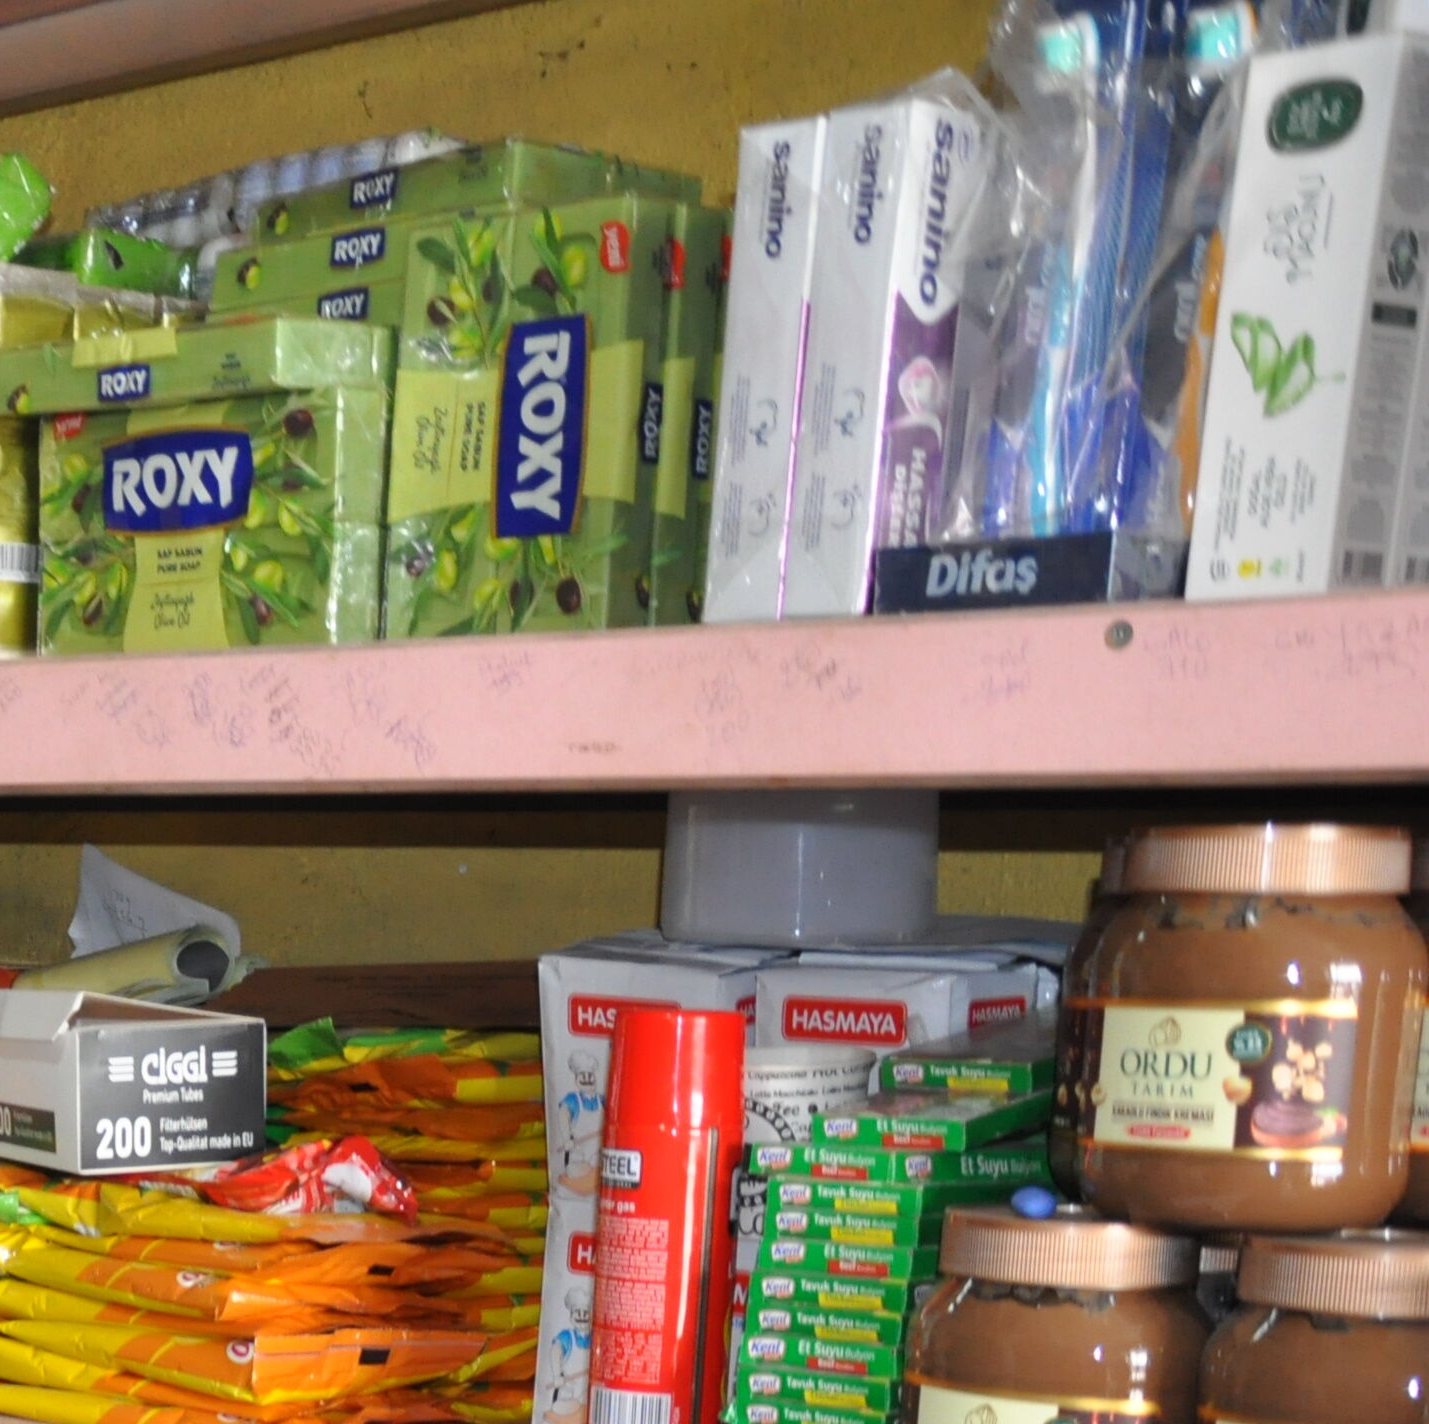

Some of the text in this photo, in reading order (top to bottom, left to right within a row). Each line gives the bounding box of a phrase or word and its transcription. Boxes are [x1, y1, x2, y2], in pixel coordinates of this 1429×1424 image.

[352, 171, 396, 205] ROXY
[333, 229, 384, 265] ROXY
[320, 291, 367, 318] ROXY
[101, 370, 147, 397] ROXY
[510, 331, 571, 520] ROXY
[112, 446, 239, 517] ROXY
[792, 1009, 896, 1035] HASMAYA
[971, 1003, 1025, 1024] HASMAYA
[894, 1065, 986, 1078] Kent Tavuk Suyu
[1121, 1048, 1212, 1080] ORDU
[143, 1087, 204, 1104] Premium Tubes
[1132, 1082, 1194, 1098] TARIM
[826, 1119, 919, 1134] Kent Et Suyu
[96, 1117, 152, 1160] 200
[210, 1131, 254, 1149] made in EU
[759, 1148, 846, 1165] Kent Et Suyu
[908, 1156, 1008, 1177] Kent Et Suyu
[782, 1186, 874, 1200] Kent Tavuk Suyu
[778, 1214, 871, 1228] Kent Tavuk Suyu
[774, 1243, 866, 1260] Kent Et Suyu
[765, 1279, 859, 1296] Kent Tavuk Suyu
[762, 1312, 854, 1329] Kent Tavuk Suyu
[750, 1340, 844, 1357] Kent Et Suyu
[752, 1377, 843, 1393] Kent Tavuk Suyu
[749, 1408, 840, 1424] Kent Tavuk Suyu
